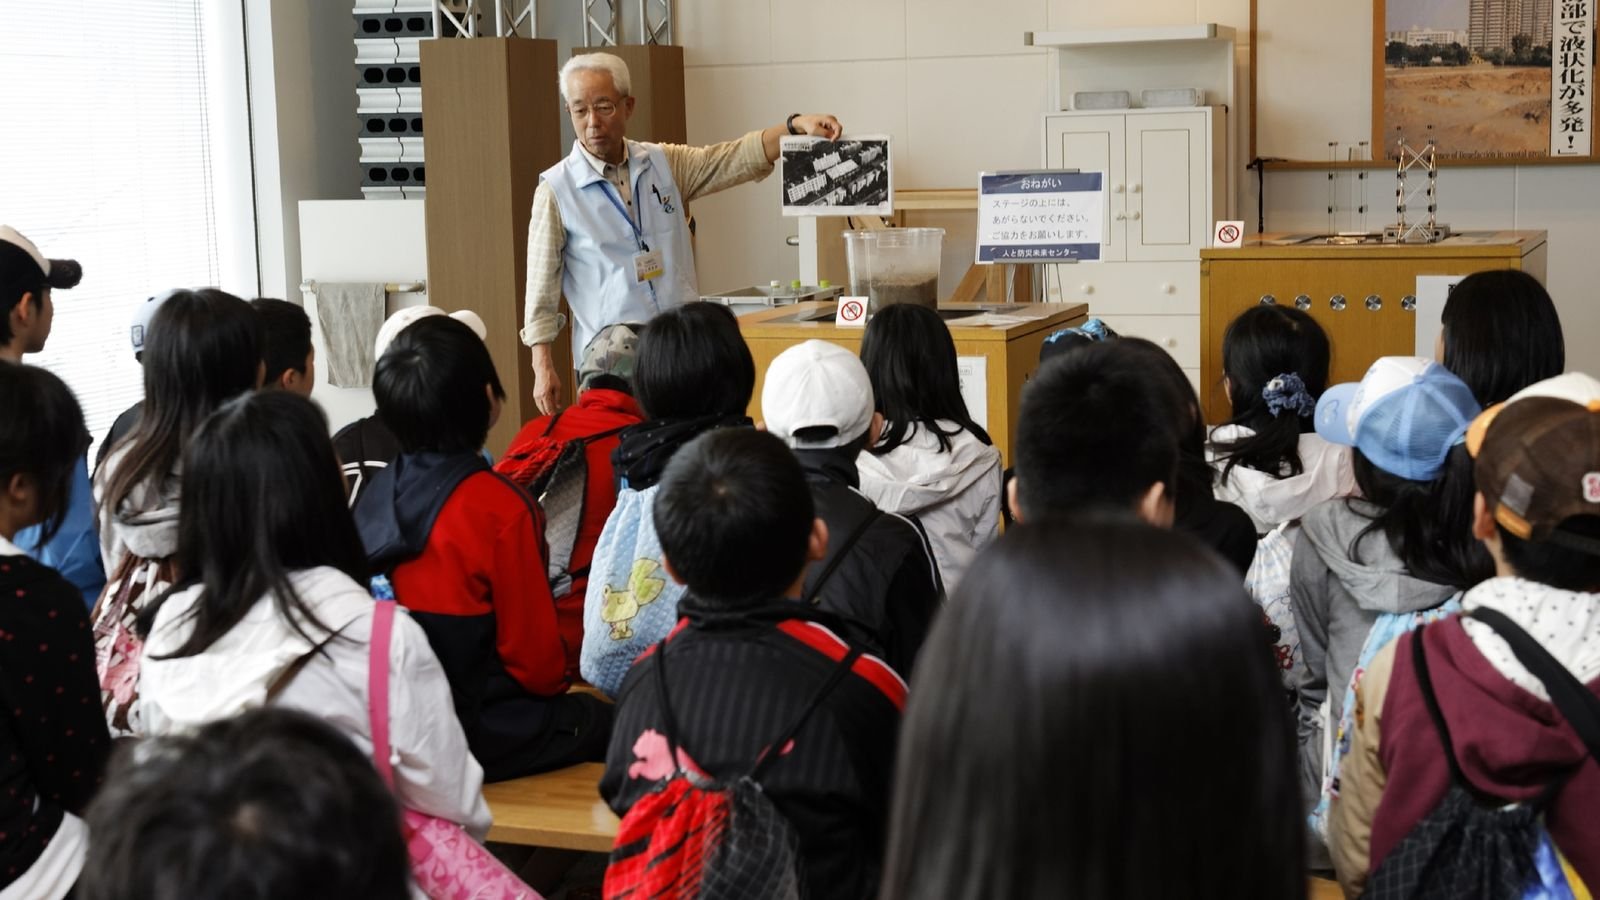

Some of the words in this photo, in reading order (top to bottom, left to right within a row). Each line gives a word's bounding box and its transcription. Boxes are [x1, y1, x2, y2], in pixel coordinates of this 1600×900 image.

[1020, 178, 1062, 190] おねがい
[992, 198, 1071, 208] ステージの上には、
[992, 214, 1089, 224] あがらないでください。
[992, 230, 1088, 240] ご協力をお願いします。
[1002, 248, 1079, 257] 人と防災未来センター
